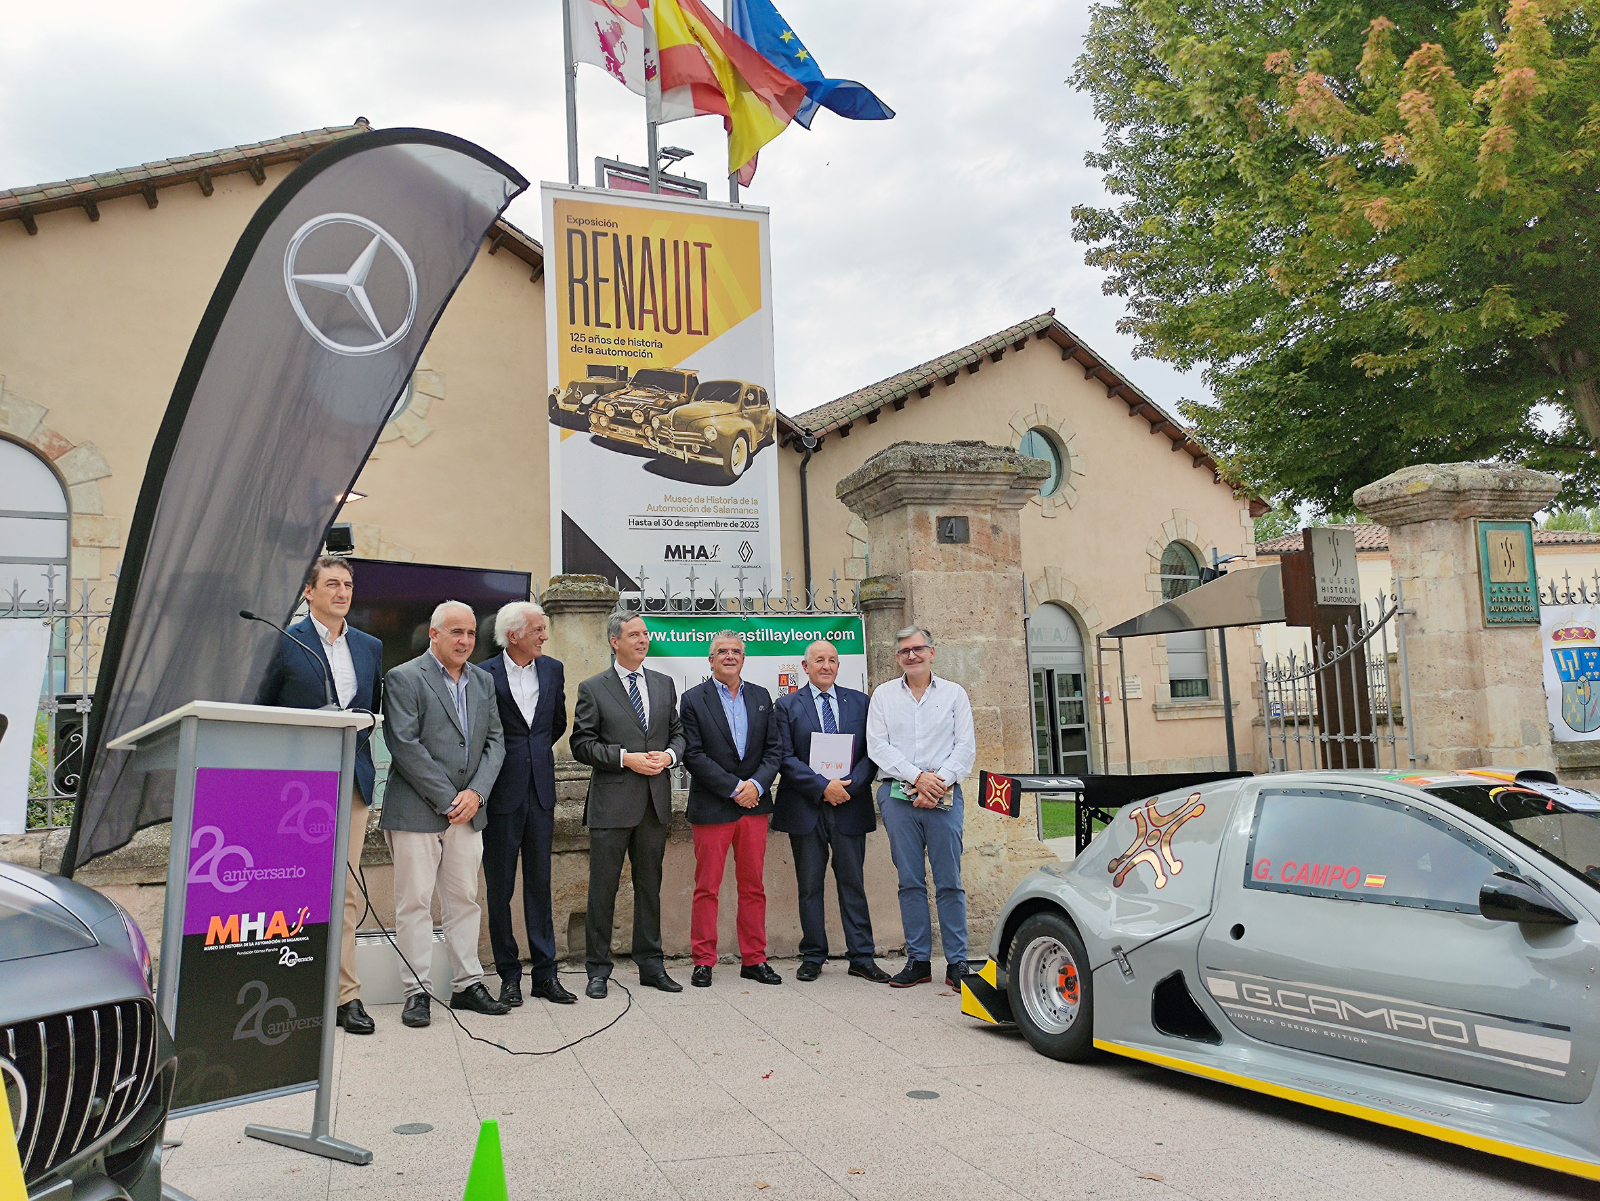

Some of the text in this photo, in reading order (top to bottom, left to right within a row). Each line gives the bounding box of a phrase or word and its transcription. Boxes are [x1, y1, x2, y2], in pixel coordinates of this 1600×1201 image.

[566, 214, 619, 229] Exposición
[566, 228, 713, 337] RENAULT
[569, 332, 663, 349] 125 años de historia
[570, 345, 653, 359] de la automoción
[664, 494, 759, 506] Museo de Historia de la
[646, 503, 759, 515] Automoción de Salamanca
[628, 518, 760, 529] Hasta el 30 de septiembre de 2023
[945, 518, 957, 541] 4
[1320, 577, 1356, 585] MUSEO
[1321, 586, 1356, 594] HISTORIA
[1491, 595, 1532, 603] HISTORIA
[187, 825, 254, 894] 20
[223, 865, 306, 883] aniversario
[1253, 857, 1361, 890] G. CAMPO
[278, 945, 299, 967] 20
[232, 980, 297, 1046] 20
[1241, 982, 1469, 1044] G.CAMPO
[1227, 1011, 1368, 1044] VINYLPAC DESIGN EDITION
